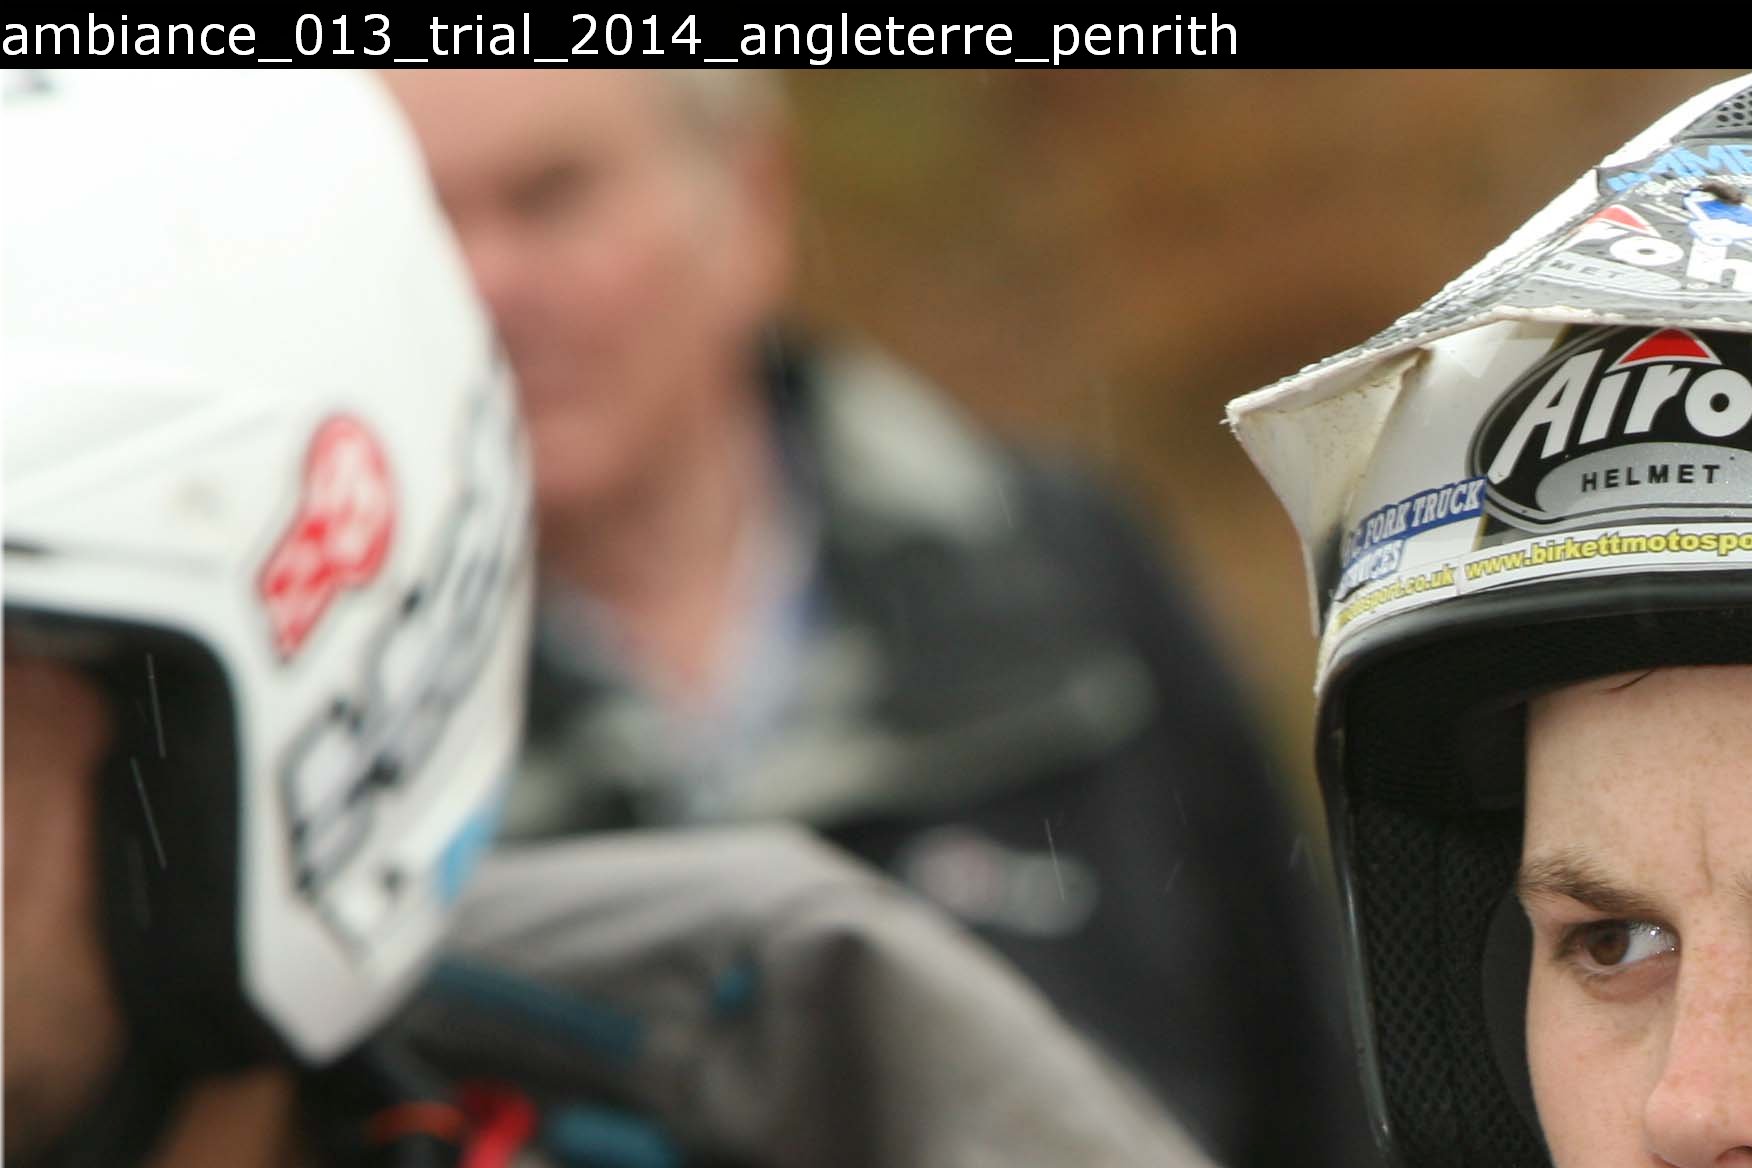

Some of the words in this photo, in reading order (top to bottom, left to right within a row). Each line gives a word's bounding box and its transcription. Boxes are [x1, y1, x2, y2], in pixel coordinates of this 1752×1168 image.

[1581, 463, 1721, 493] HELMET
[1364, 501, 1410, 550] FORK
[1411, 478, 1485, 528] TRUCK
